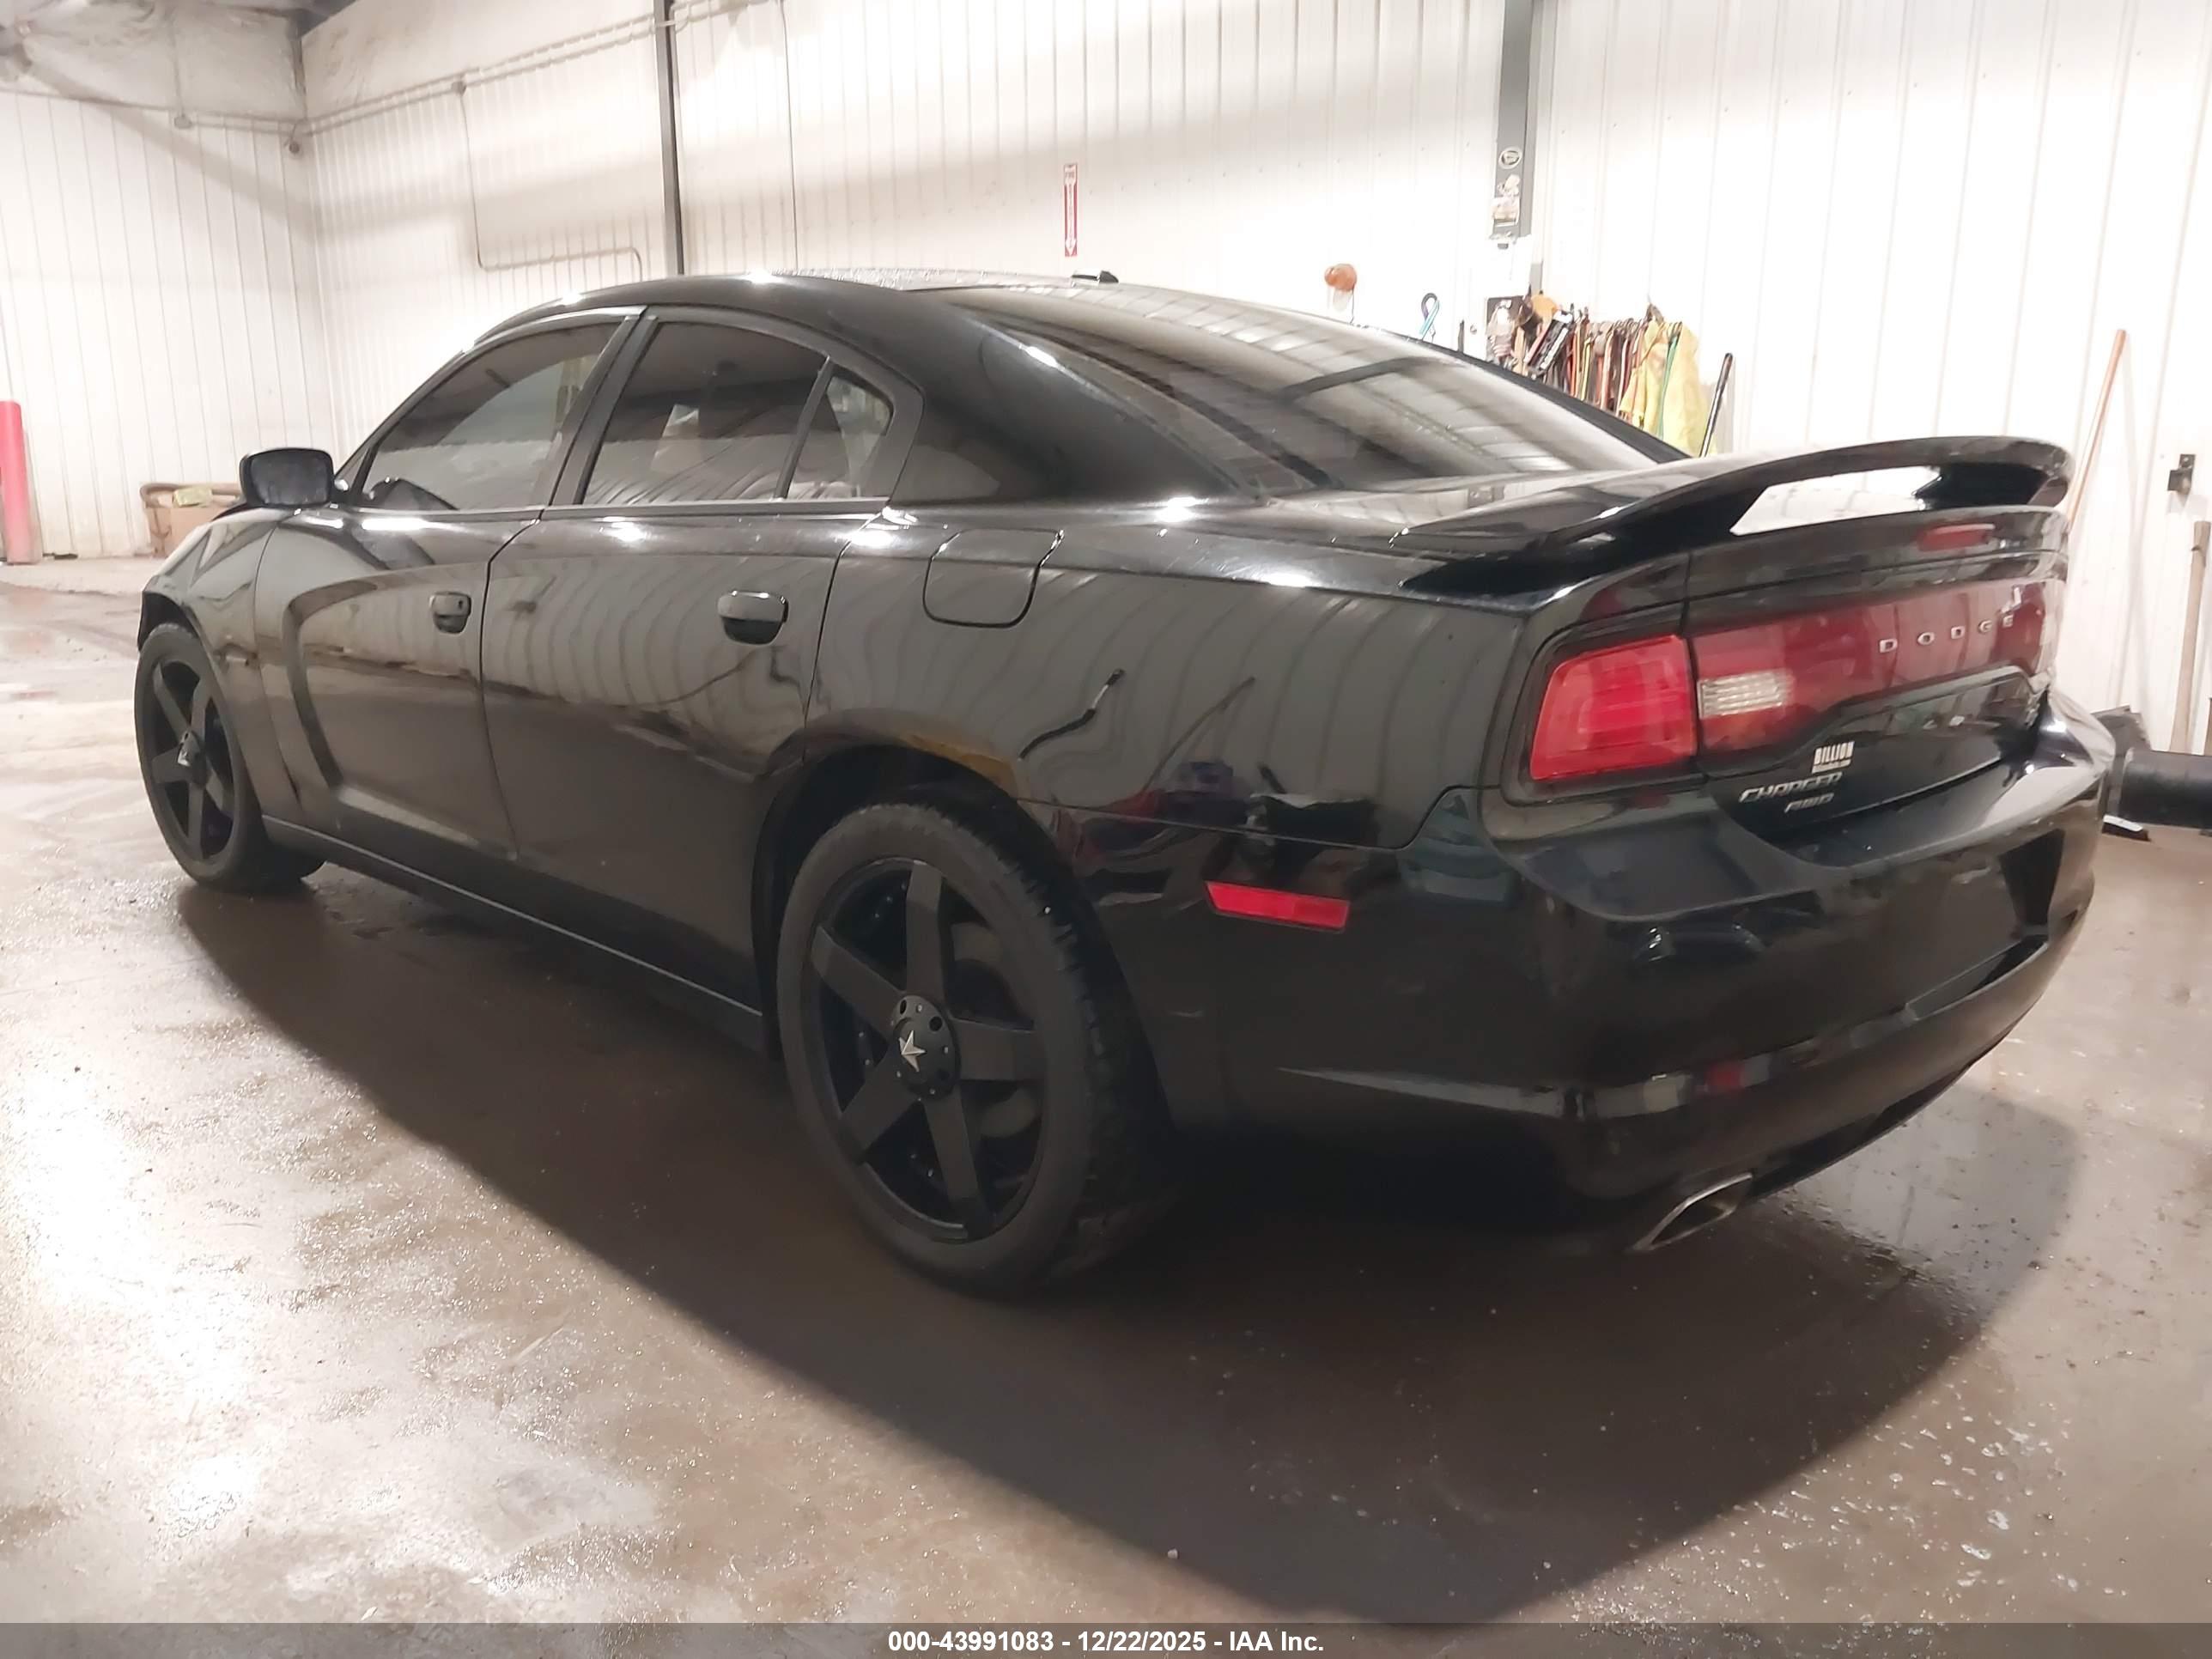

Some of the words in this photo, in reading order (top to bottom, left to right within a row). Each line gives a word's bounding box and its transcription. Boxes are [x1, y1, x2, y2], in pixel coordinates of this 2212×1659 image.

[1879, 614, 2014, 653] DODGE
[1814, 741, 1855, 765] BILLION
[1739, 771, 1844, 803] CHARGER
